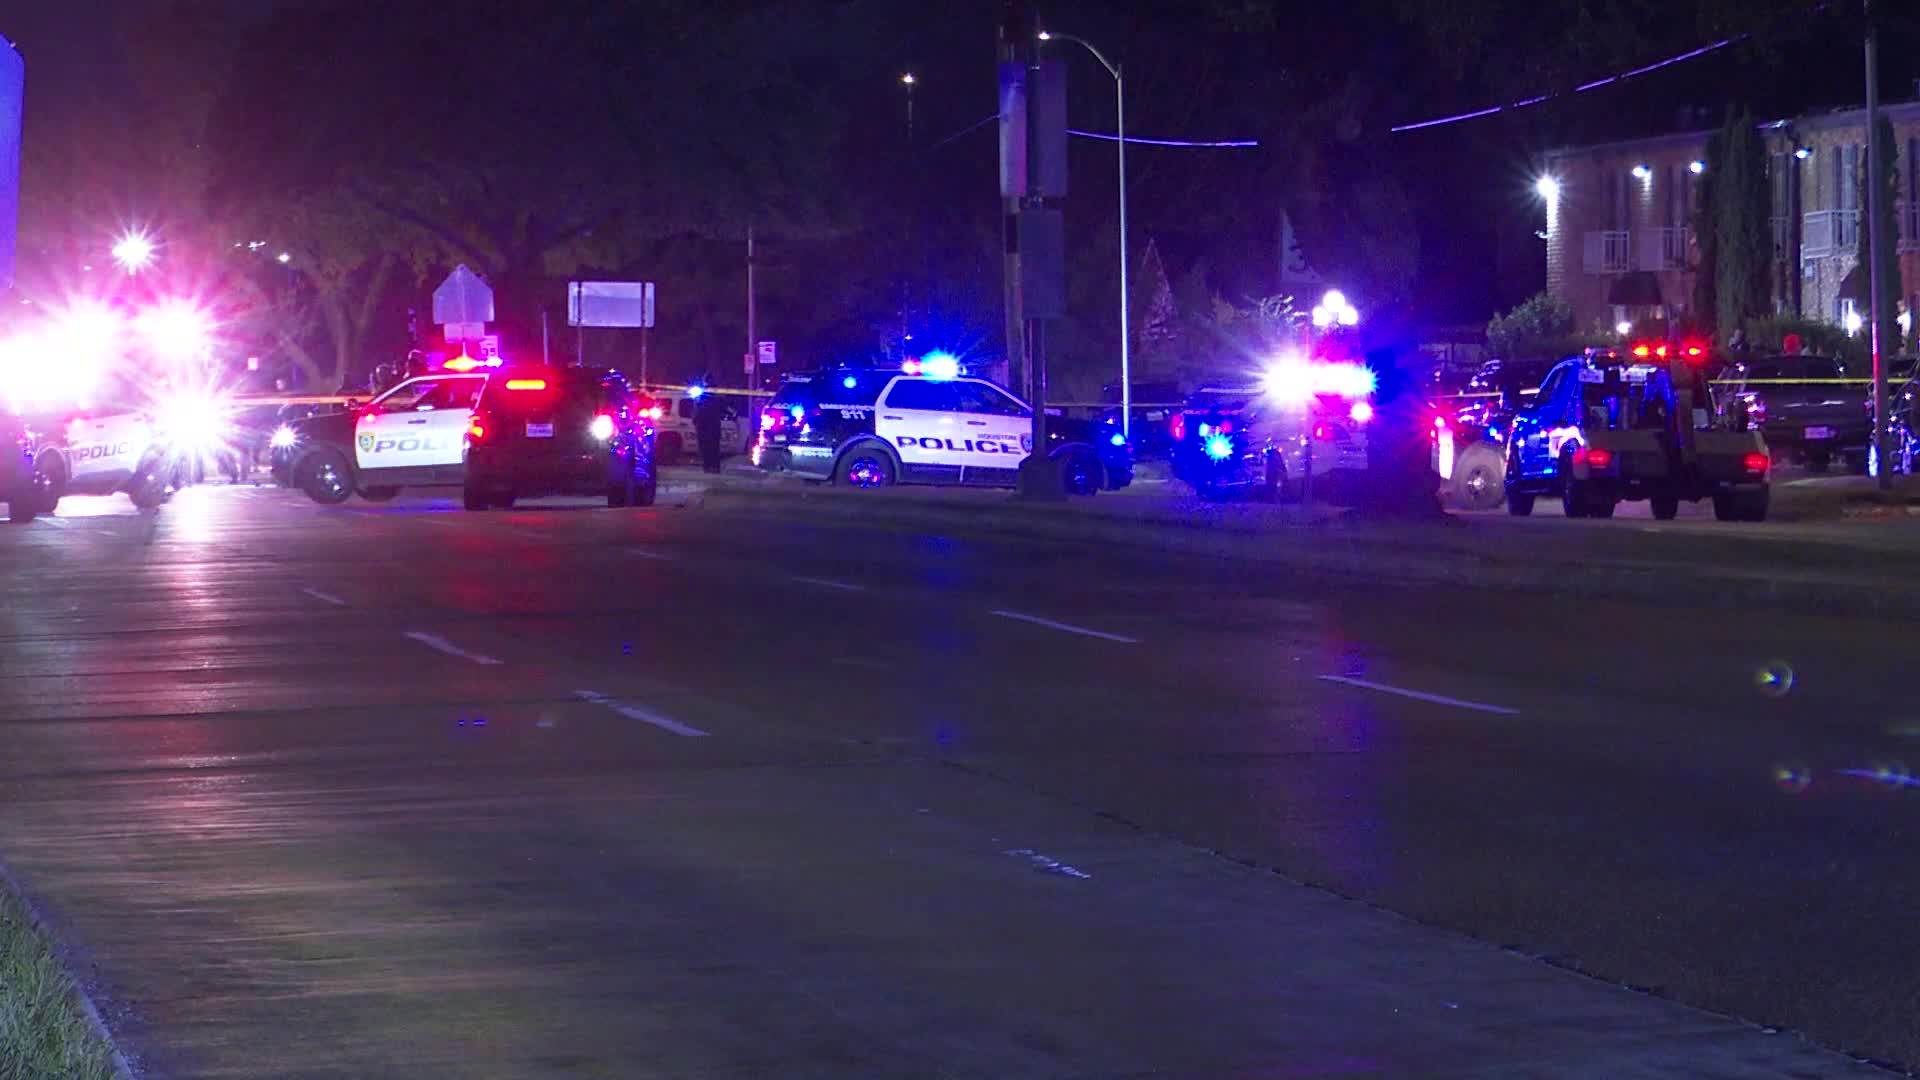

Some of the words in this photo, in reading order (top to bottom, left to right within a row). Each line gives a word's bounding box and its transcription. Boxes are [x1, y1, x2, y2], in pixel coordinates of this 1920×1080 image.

[840, 409, 866, 420] 911
[79, 441, 129, 461] POLIC
[896, 436, 1021, 455] POLICE
